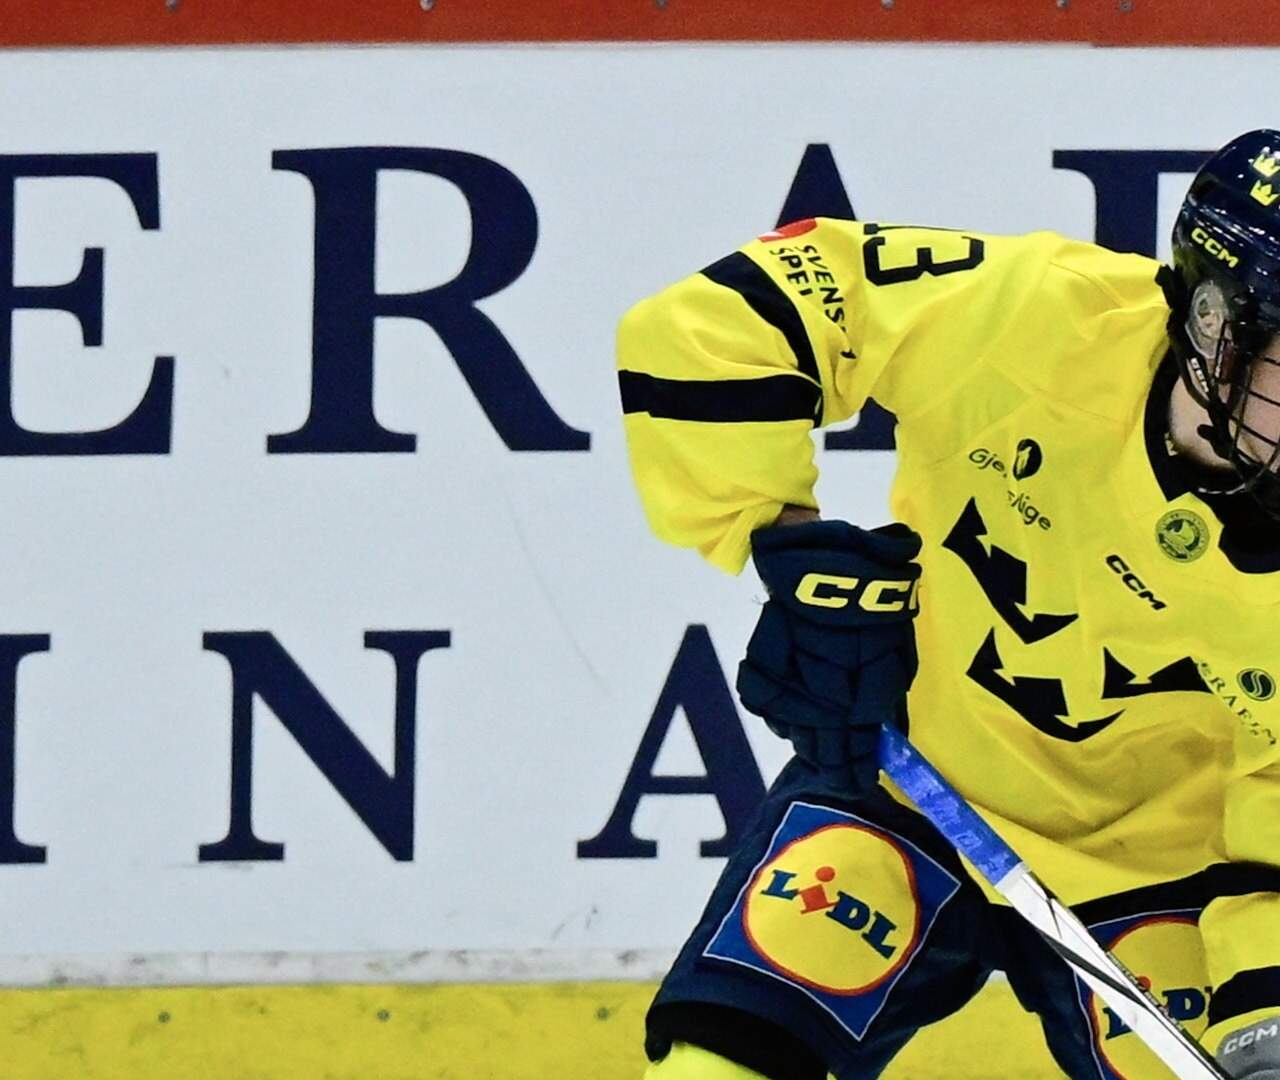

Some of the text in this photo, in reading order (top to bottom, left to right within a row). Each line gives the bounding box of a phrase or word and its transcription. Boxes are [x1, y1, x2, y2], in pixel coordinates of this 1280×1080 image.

[1190, 227, 1239, 269] CCM
[796, 244, 857, 360] SVENS
[1105, 554, 1167, 611] CCM
[1102, 975, 1214, 1041] LD
[1223, 1023, 1279, 1056] CCM
